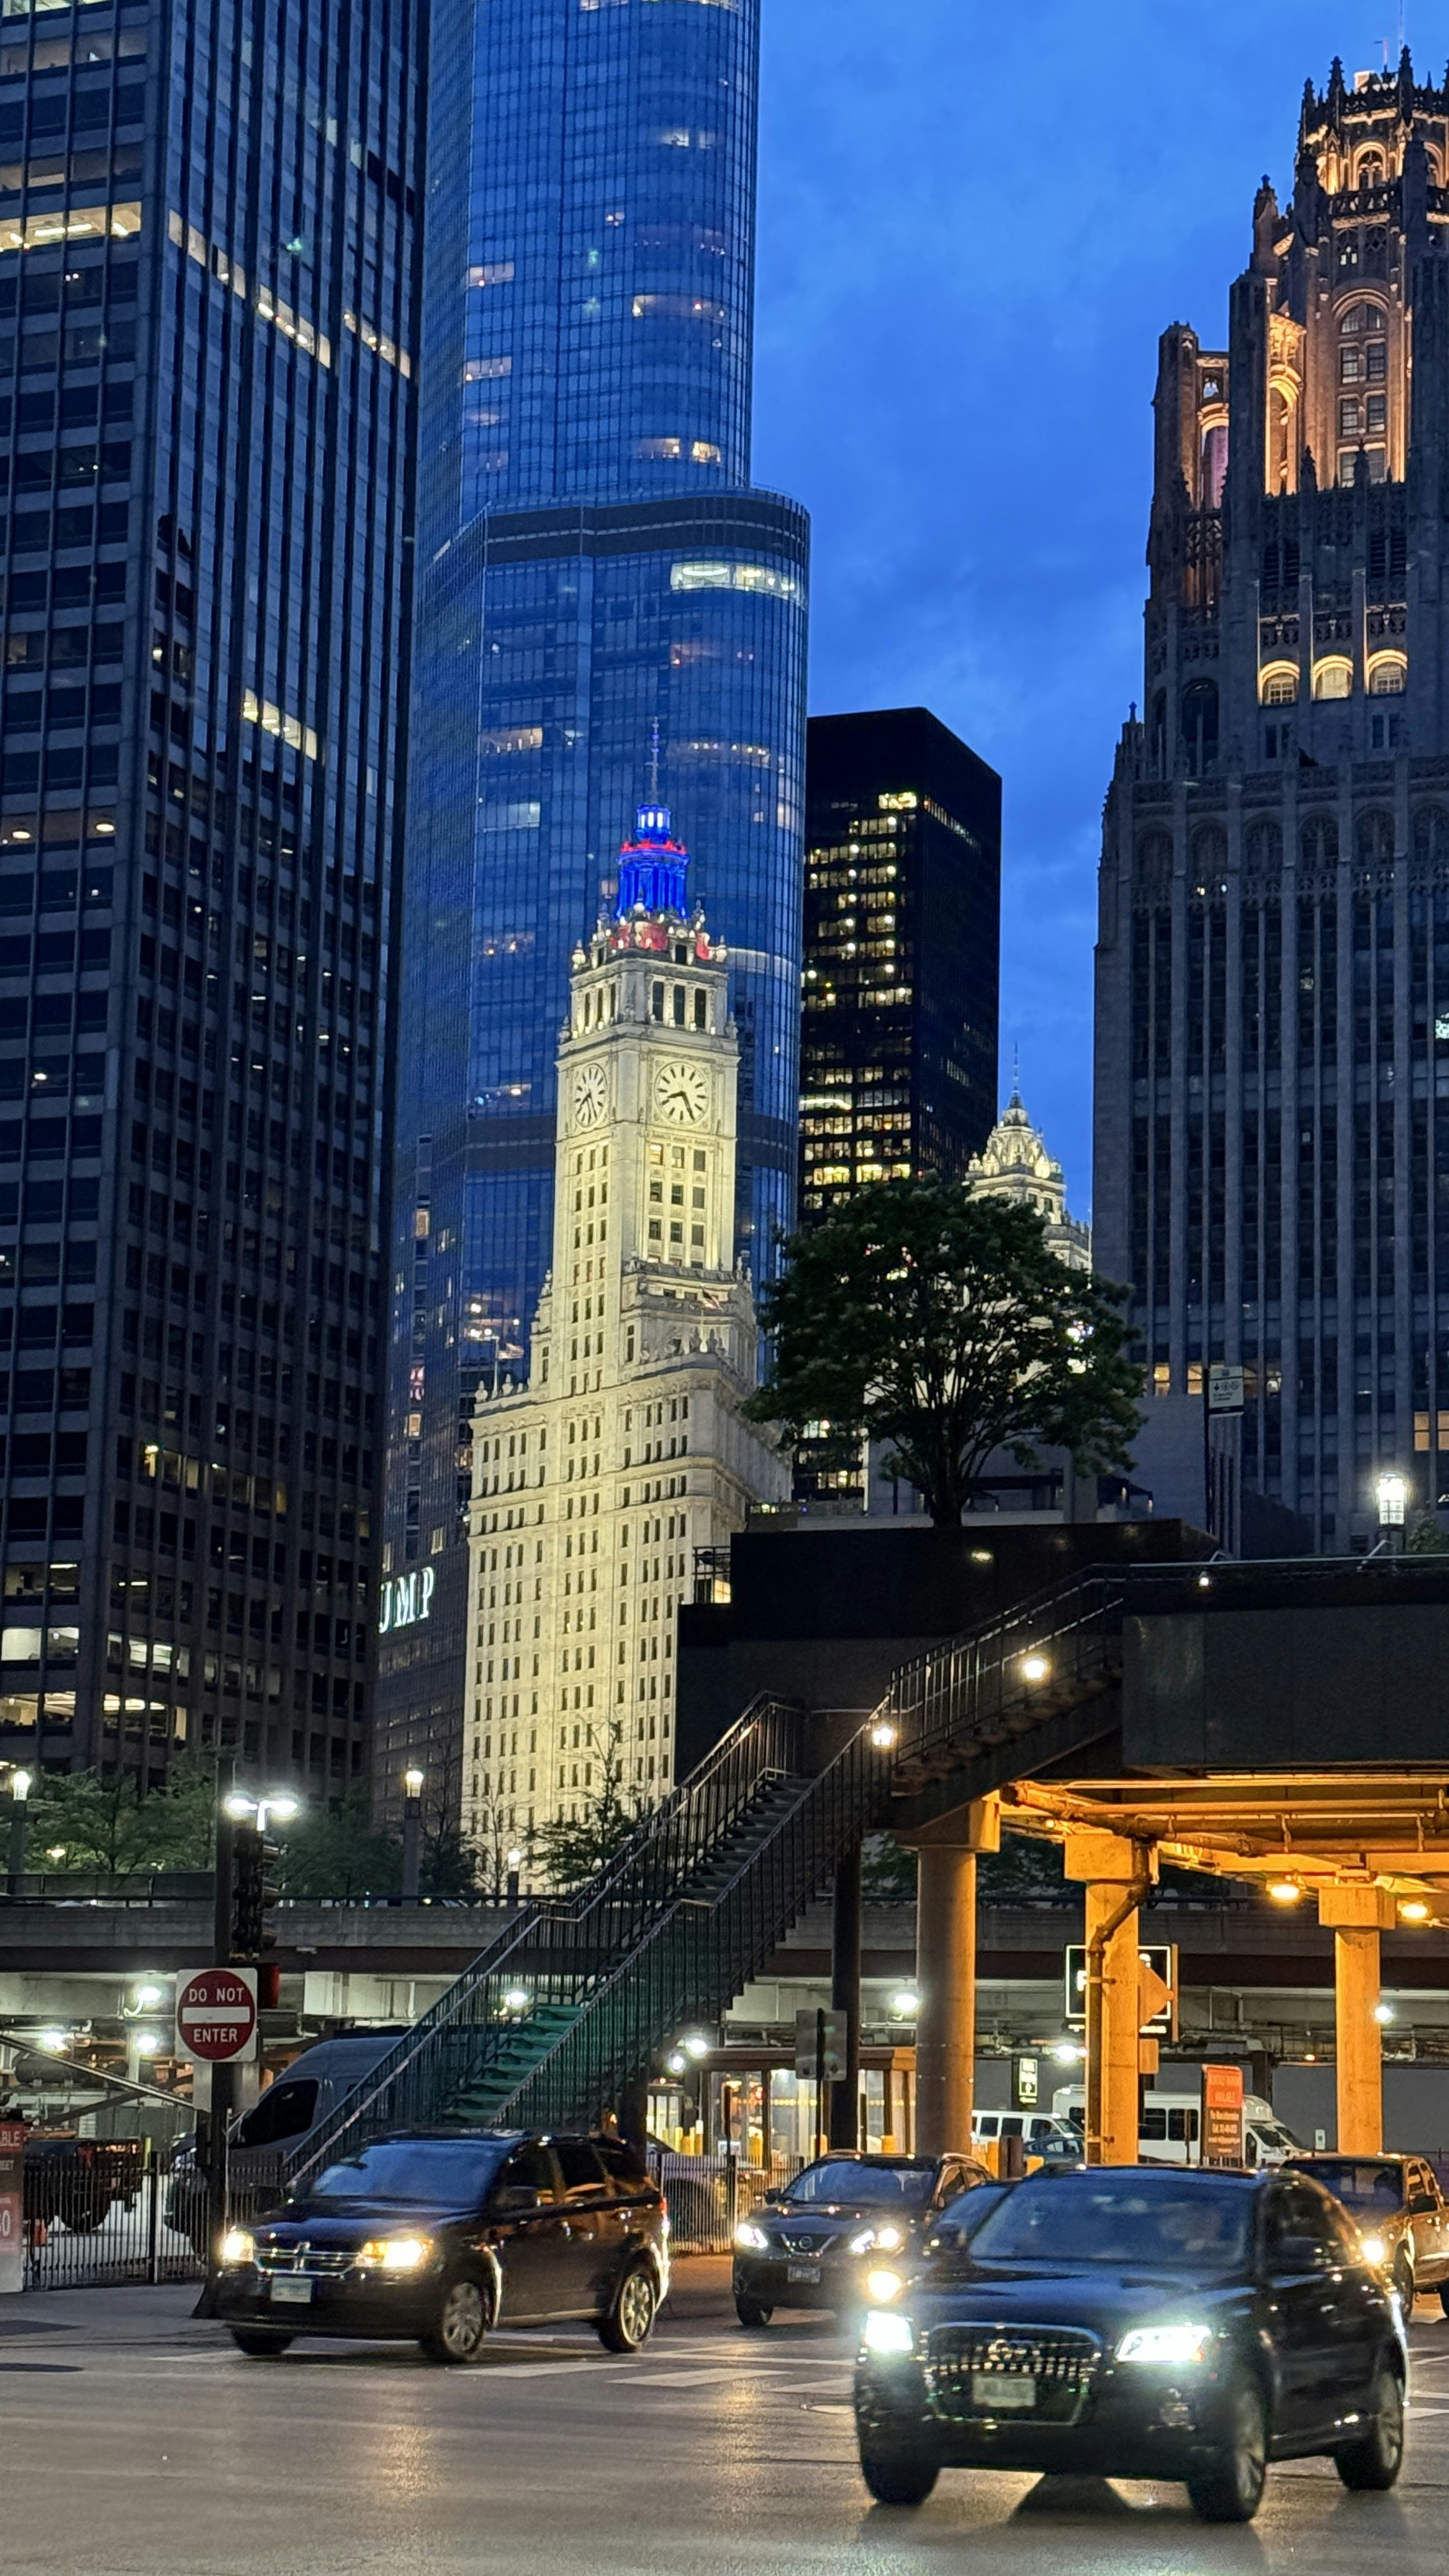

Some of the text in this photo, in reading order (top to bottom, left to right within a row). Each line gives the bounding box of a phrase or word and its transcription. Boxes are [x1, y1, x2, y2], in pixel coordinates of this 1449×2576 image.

[189, 1987, 245, 2002] DO NOT
[194, 2028, 238, 2043] ENTER
[0, 2130, 20, 2147] BLE
